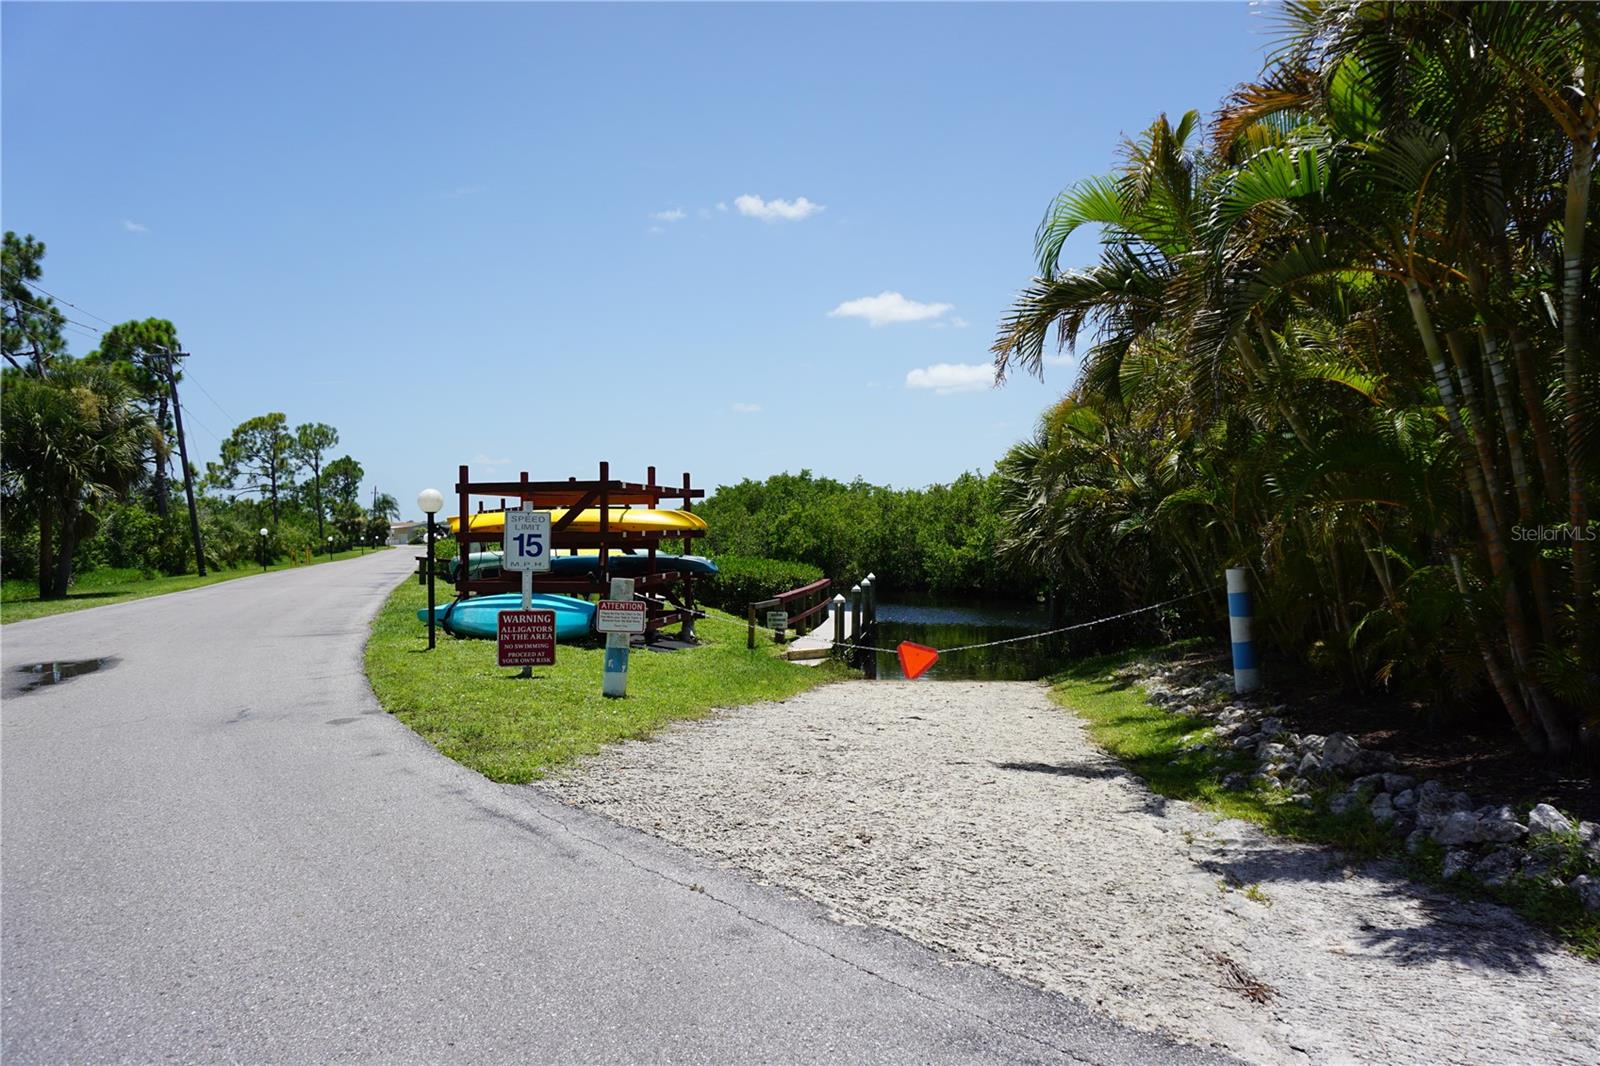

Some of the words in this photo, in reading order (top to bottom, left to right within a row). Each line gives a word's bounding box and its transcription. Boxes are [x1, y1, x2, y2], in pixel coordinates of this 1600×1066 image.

[511, 515, 546, 523] SPEED
[512, 533, 543, 558] 15
[601, 602, 643, 610] ATTENTION
[502, 614, 552, 623] WARNING
